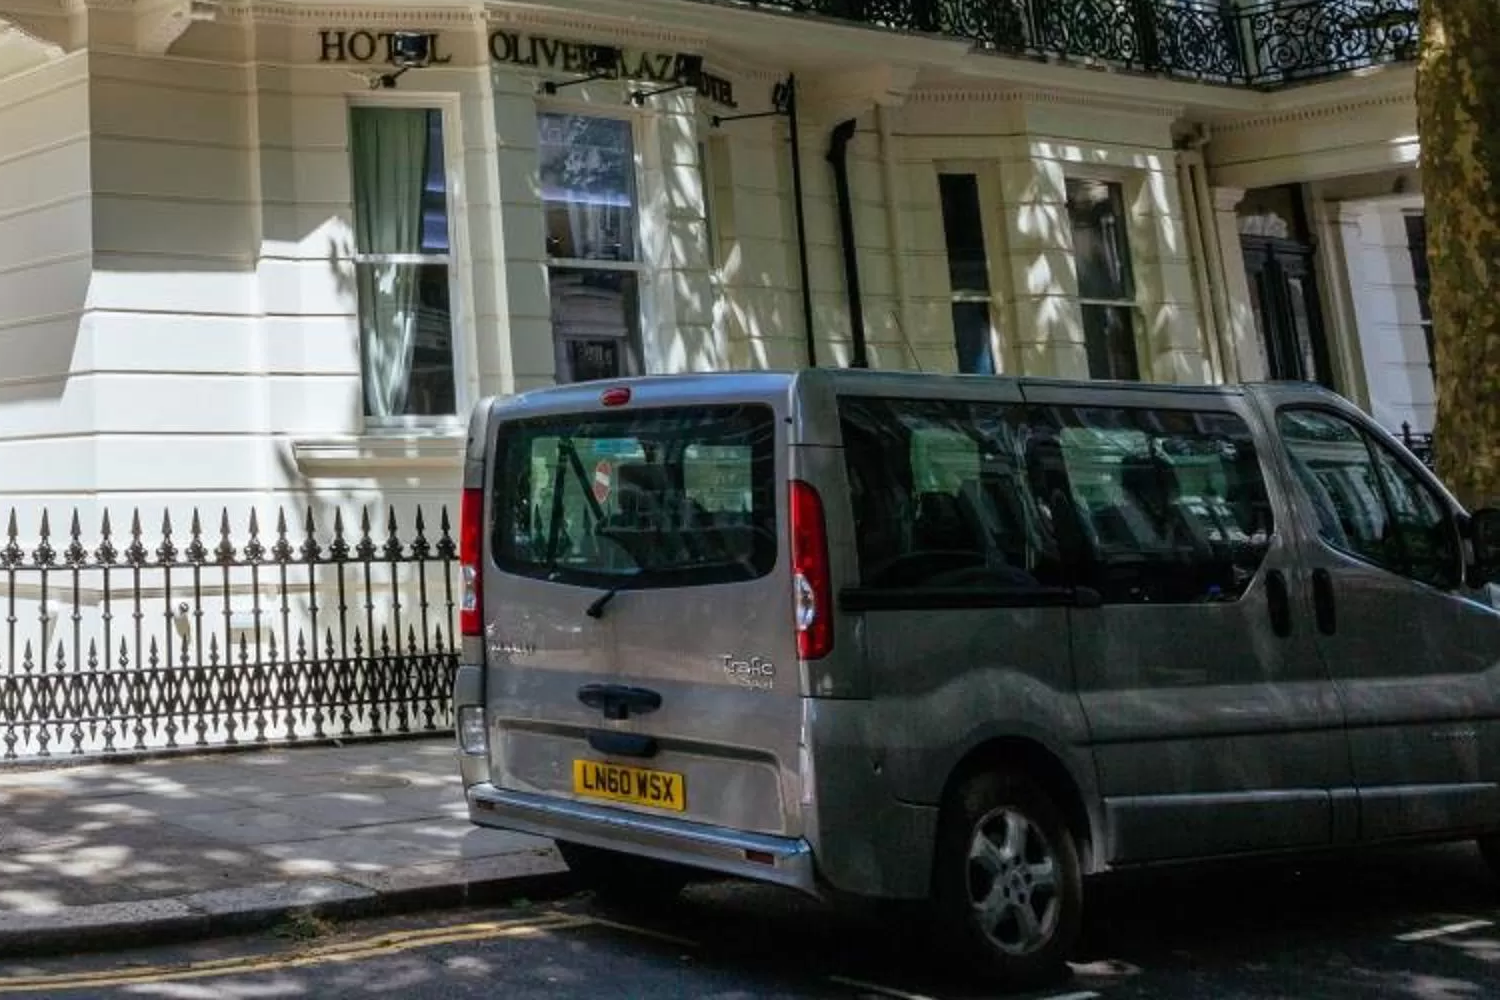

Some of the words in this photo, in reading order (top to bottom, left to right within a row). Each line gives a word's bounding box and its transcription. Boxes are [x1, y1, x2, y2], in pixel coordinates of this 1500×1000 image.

[318, 30, 453, 64] HOTL
[581, 763, 632, 796] LN60
[636, 770, 675, 803] WSX
